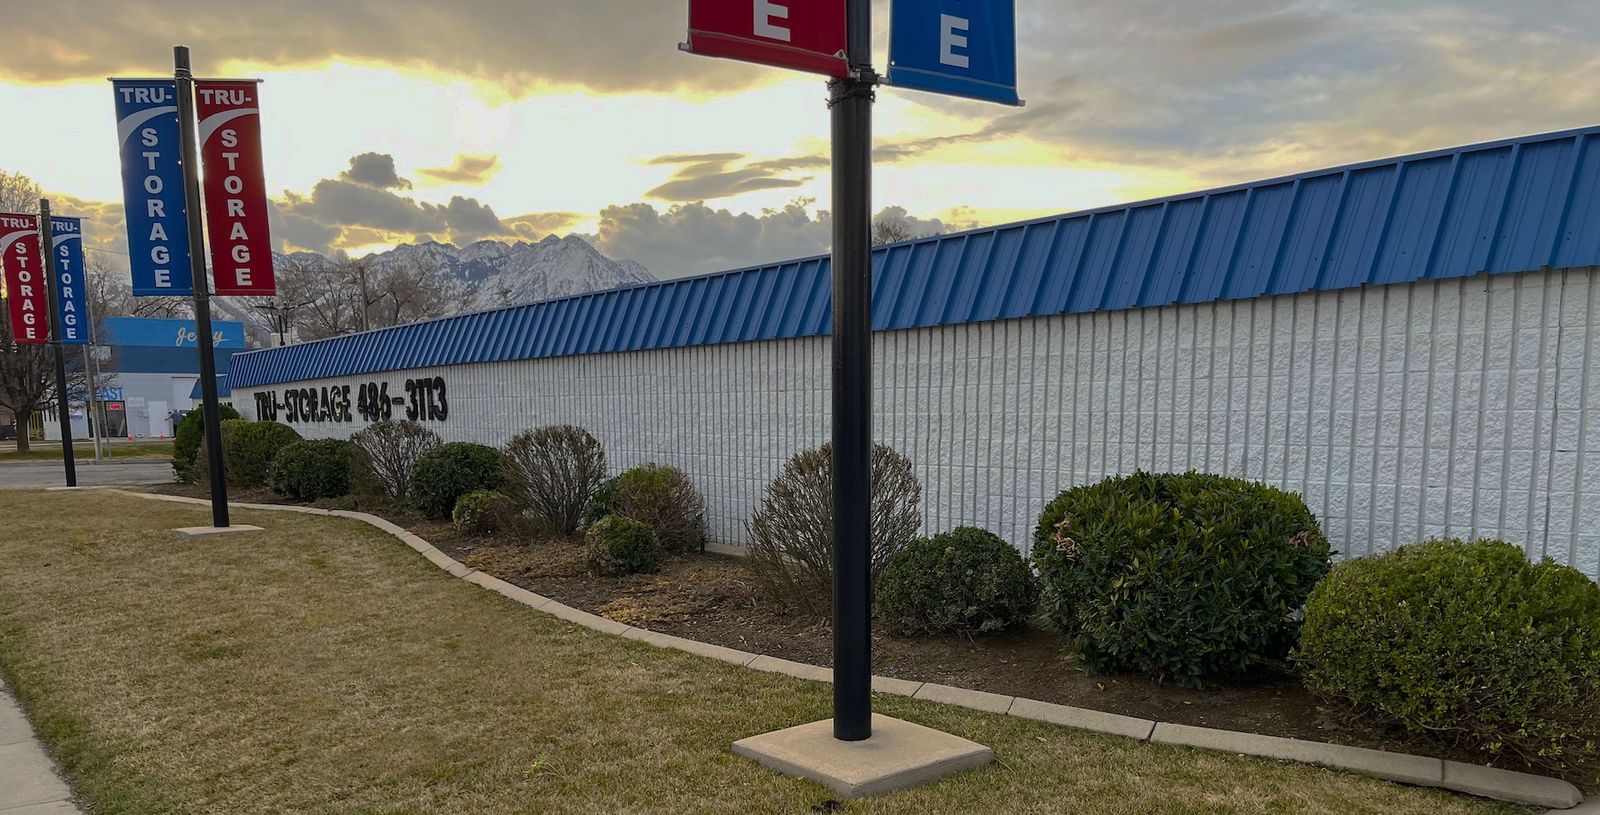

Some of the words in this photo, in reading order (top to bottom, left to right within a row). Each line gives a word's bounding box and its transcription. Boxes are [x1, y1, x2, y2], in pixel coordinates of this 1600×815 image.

[939, 13, 970, 69] E
[119, 87, 173, 104] TRU-
[199, 89, 252, 105] TRU-
[1, 217, 35, 229] TRU-
[140, 127, 172, 288] STORAGE
[220, 129, 253, 286] STORAGE
[15, 242, 36, 339] STORAGE
[59, 245, 77, 339] STORAGE
[175, 327, 230, 348] Jey
[254, 384, 353, 423] TRU-STORAGE
